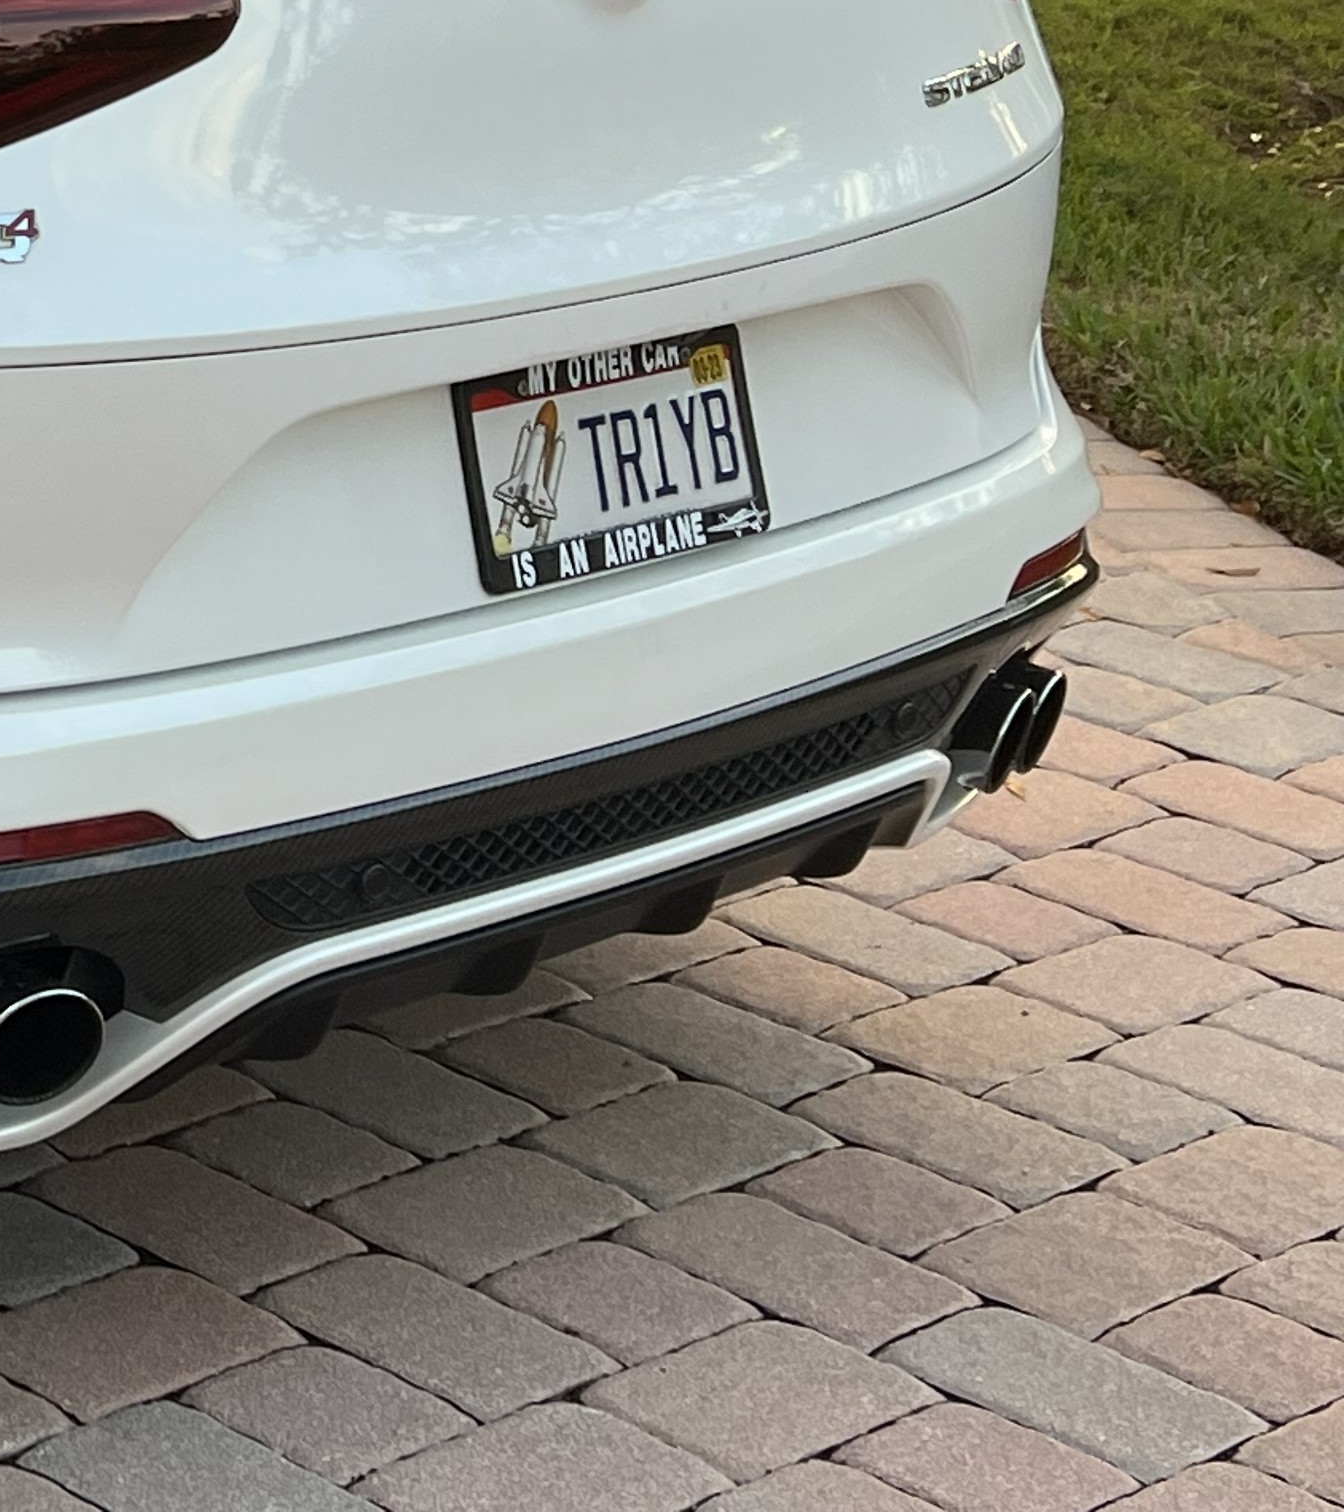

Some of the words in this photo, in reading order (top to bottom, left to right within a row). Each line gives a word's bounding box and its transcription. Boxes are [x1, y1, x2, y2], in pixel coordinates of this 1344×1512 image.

[527, 361, 557, 396] MY
[567, 345, 634, 389] OTHER
[578, 389, 739, 512] TR1YB
[511, 550, 538, 589] IS
[558, 538, 590, 578] AN
[604, 511, 707, 568] AIRPLANE
